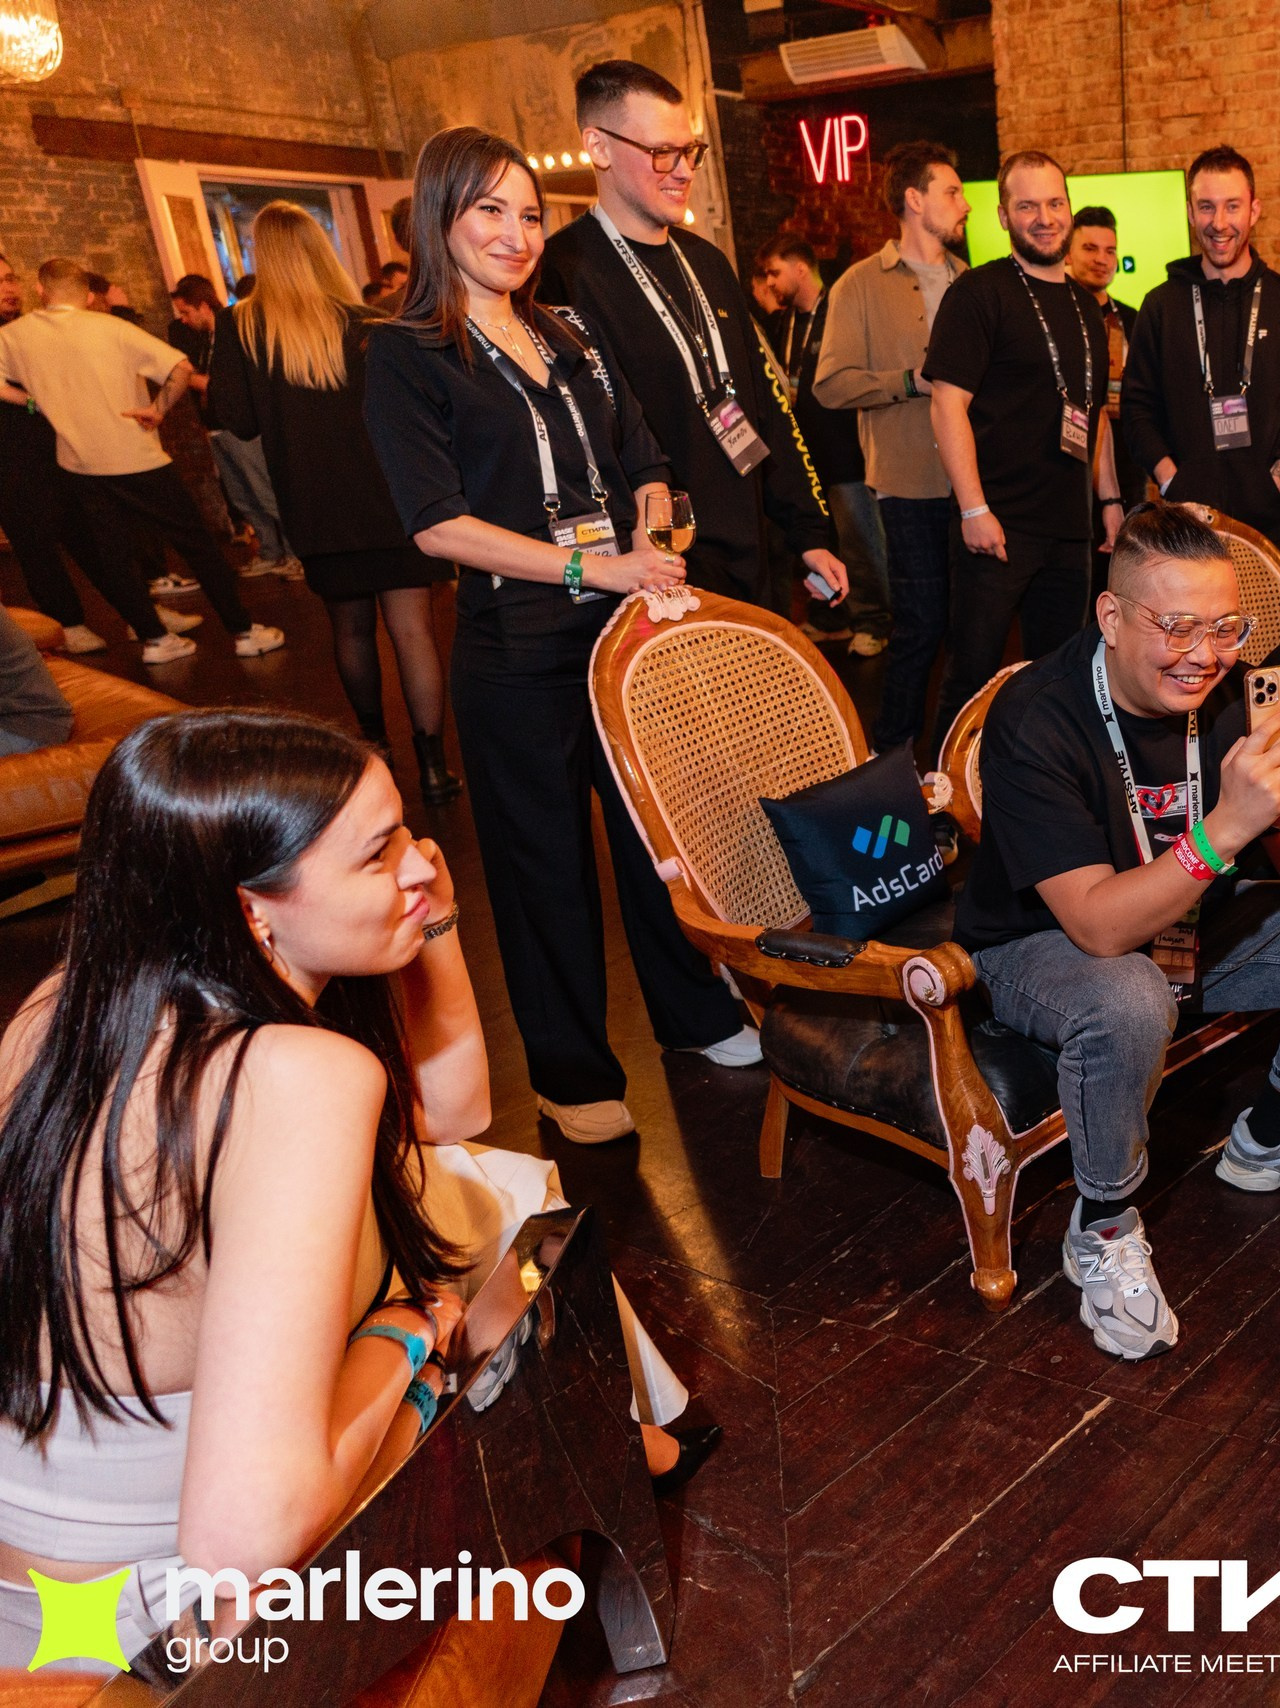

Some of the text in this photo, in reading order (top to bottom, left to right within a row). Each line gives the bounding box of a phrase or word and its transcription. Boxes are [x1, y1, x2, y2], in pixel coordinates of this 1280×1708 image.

[799, 114, 867, 183] VIP
[565, 396, 585, 438] marlerino
[1097, 665, 1109, 711] marlerino
[1115, 750, 1139, 815] AFFSTYLE
[852, 844, 944, 912] AdsCard
[1198, 862, 1206, 871] 5
